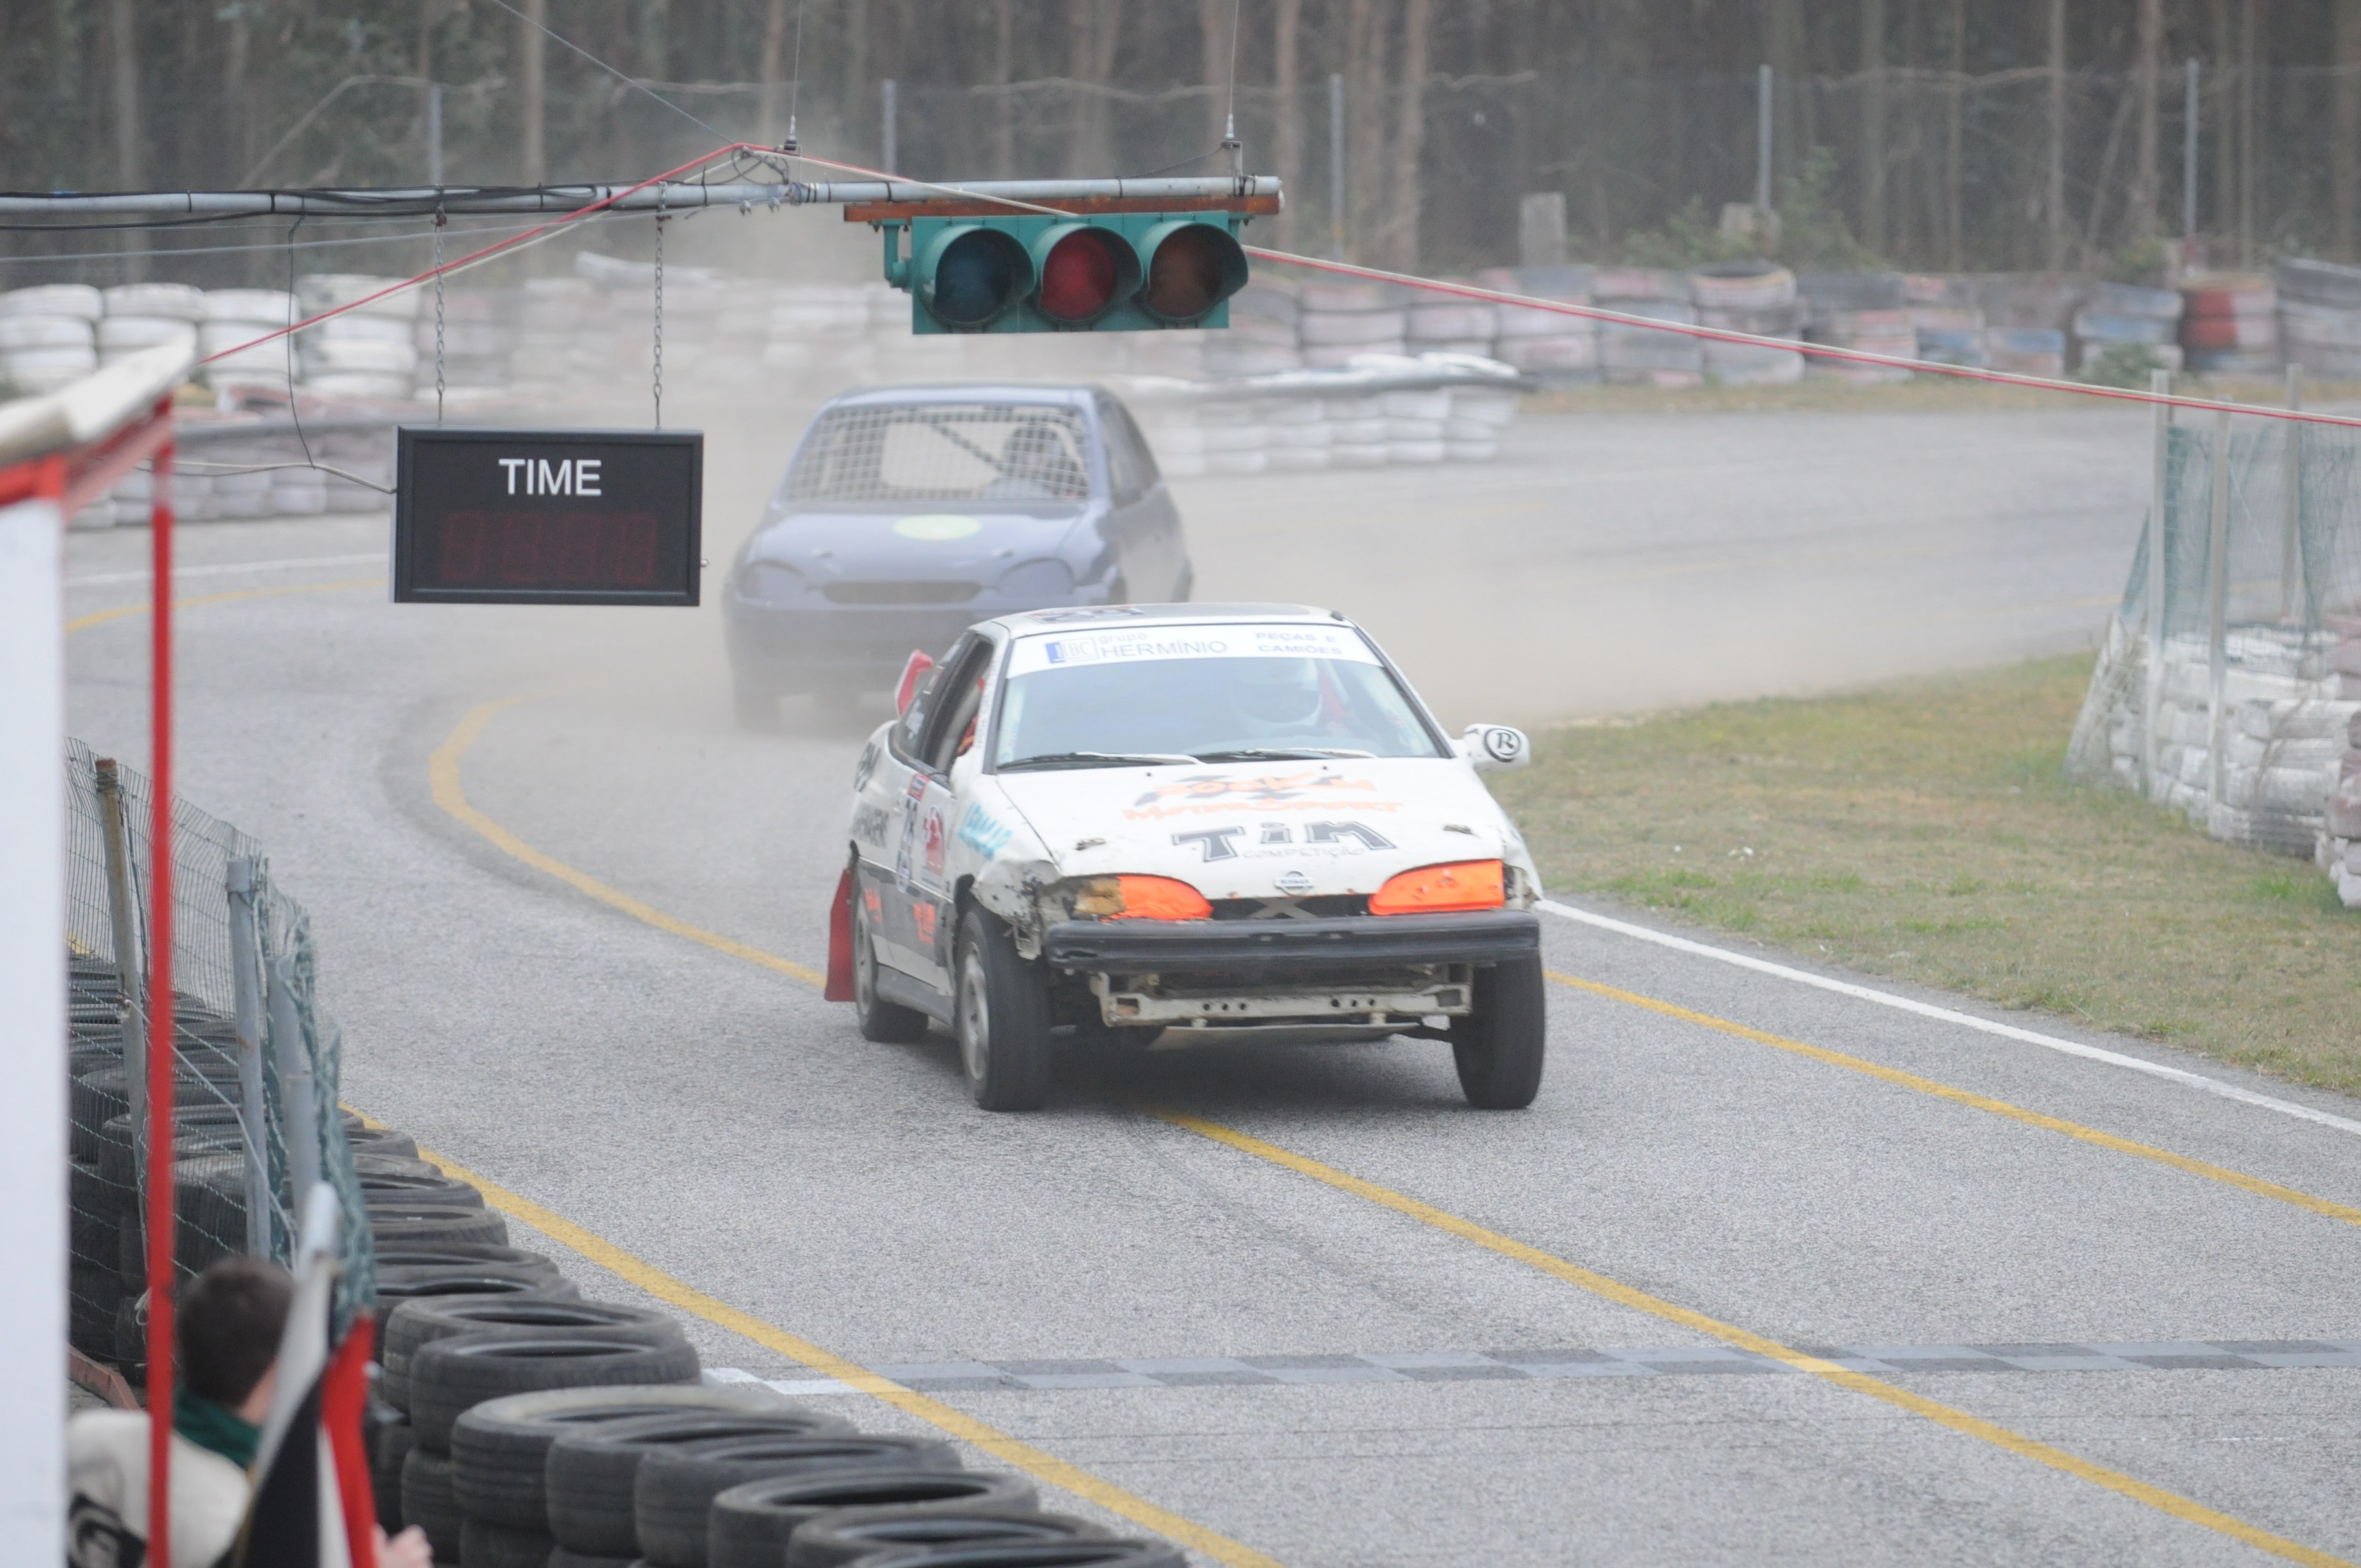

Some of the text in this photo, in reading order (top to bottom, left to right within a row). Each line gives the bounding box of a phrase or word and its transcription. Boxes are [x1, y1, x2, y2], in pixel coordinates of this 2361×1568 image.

[498, 459, 601, 496] TIME
[1098, 633, 1148, 645] grupo
[1255, 631, 1337, 644] PEÇAS E
[1100, 638, 1228, 658] HERMÍNIO
[1257, 643, 1343, 656] CAMIÕES
